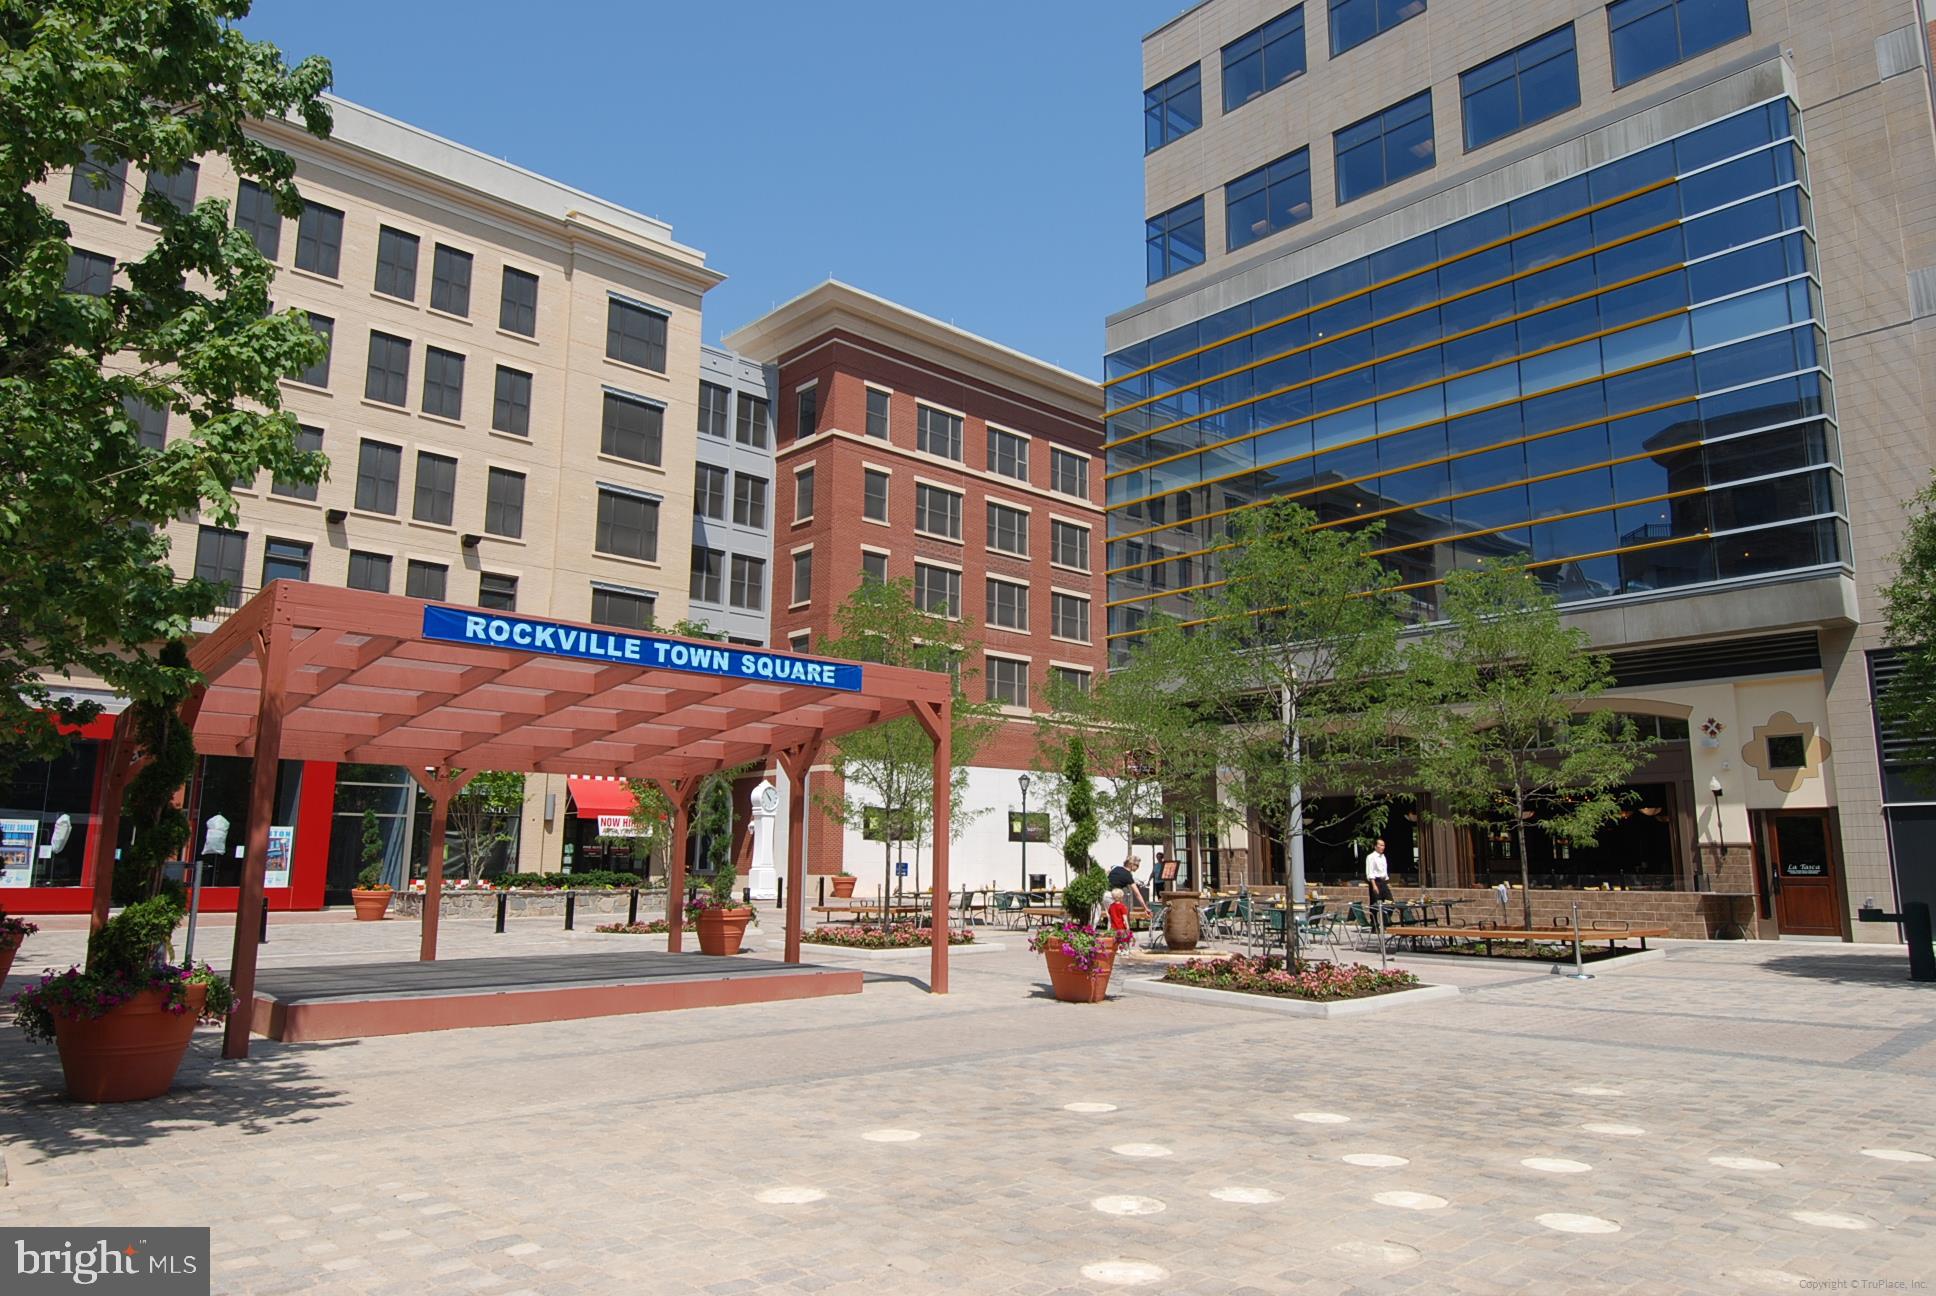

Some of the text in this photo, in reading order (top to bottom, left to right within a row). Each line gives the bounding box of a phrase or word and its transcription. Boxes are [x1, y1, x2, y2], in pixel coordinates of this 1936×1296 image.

[466, 616, 836, 683] ROCKVILLE TOWN SQUARE
[601, 817, 620, 827] NOW
